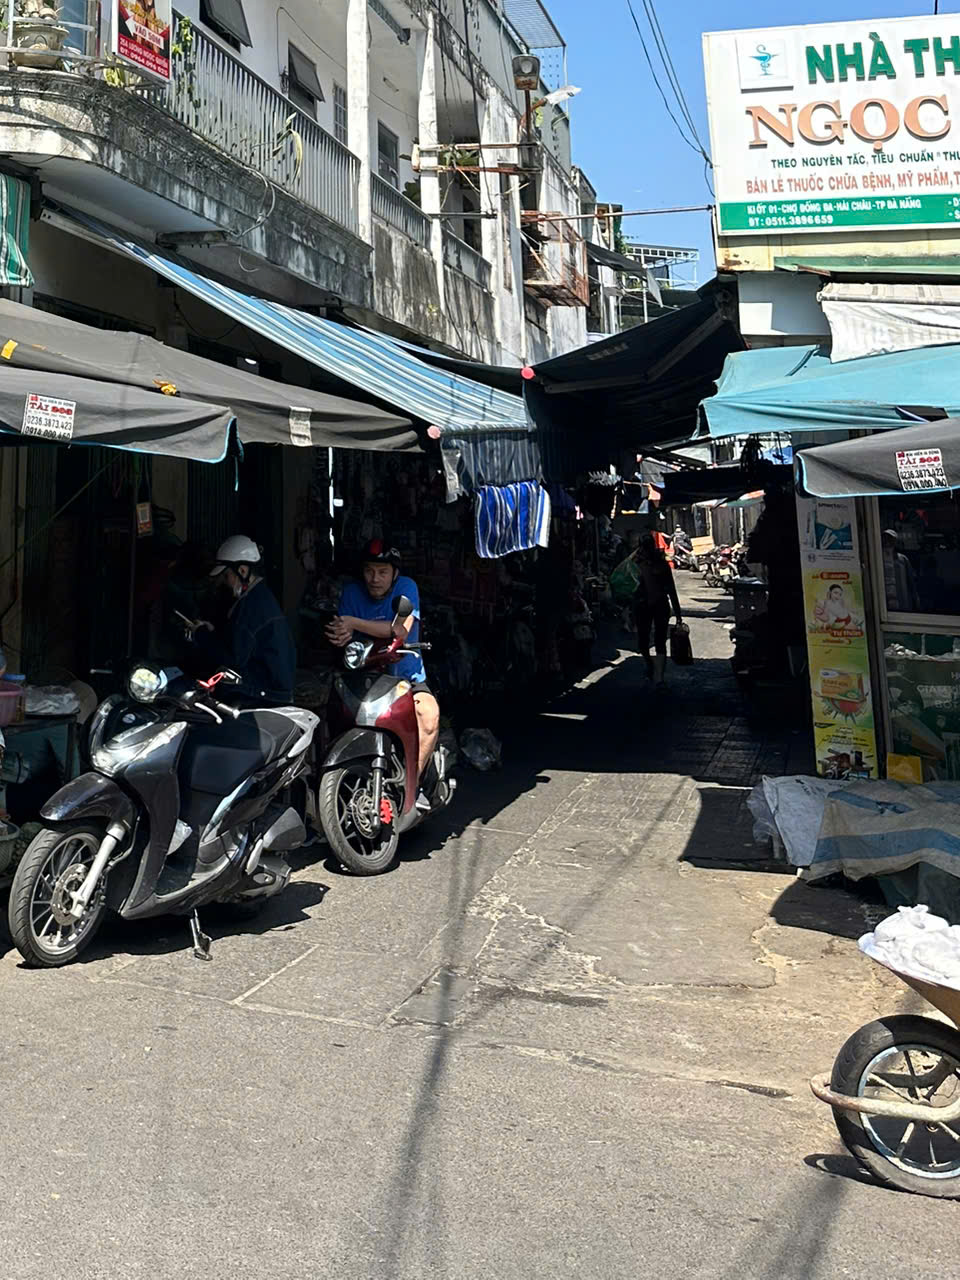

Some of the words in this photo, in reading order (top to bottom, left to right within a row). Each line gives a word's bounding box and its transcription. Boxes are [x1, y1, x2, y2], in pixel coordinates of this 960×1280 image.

[805, 32, 897, 84] NHÀ
[745, 94, 952, 152] NGỌC
[770, 158, 798, 169] THEO
[801, 153, 843, 168] NGUYÊN
[899, 148, 935, 164] CHUẨN
[745, 175, 769, 195] BÁN
[770, 172, 785, 193] LẺ
[786, 172, 825, 194] THUỐC
[828, 171, 859, 191] CHỮA
[861, 171, 896, 192] BỆNH,
[896, 169, 914, 188] MỸ
[917, 165, 954, 188] PHẨM,
